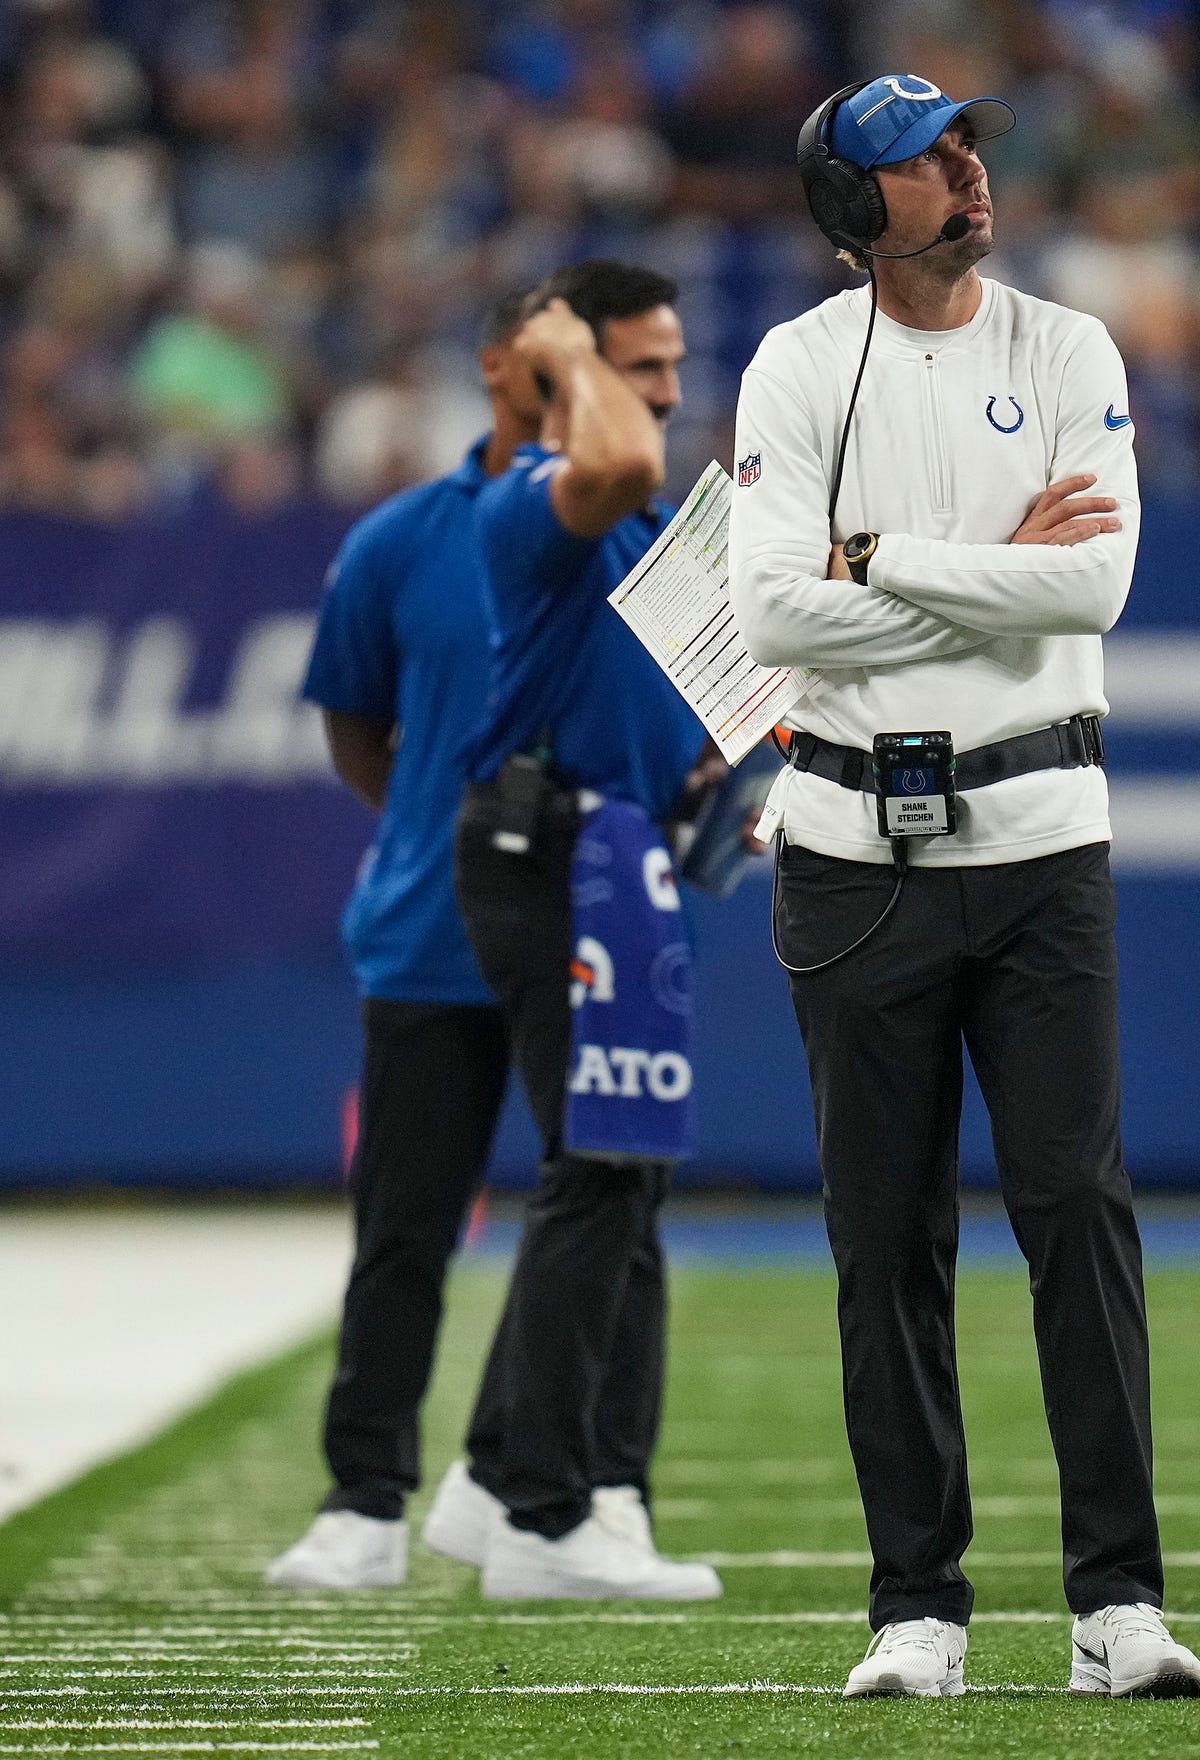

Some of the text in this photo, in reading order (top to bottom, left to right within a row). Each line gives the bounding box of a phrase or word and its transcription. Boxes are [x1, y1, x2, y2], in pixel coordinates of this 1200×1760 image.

[741, 466, 759, 484] NFL
[902, 802, 928, 811] SHANE
[897, 813, 934, 823] STEICHEN
